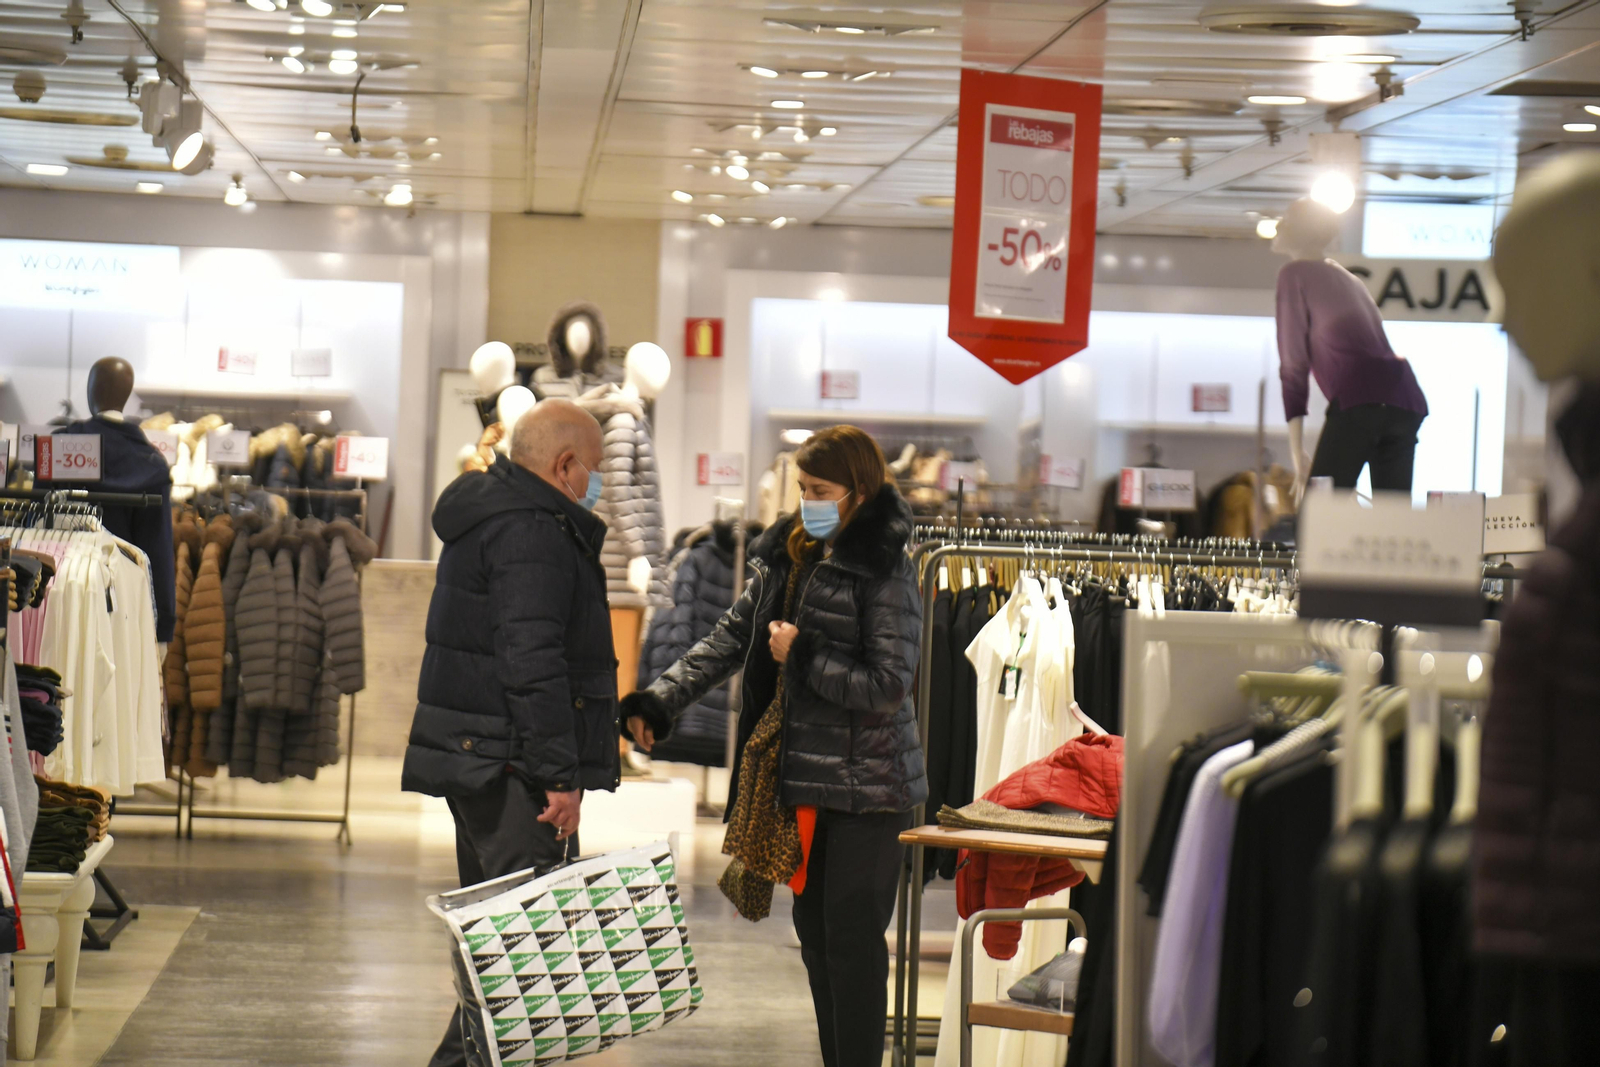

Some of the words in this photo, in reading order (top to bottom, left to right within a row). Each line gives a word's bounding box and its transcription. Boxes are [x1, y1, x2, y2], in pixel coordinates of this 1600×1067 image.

[1008, 123, 1054, 145] rebajas
[998, 169, 1067, 205] TODO
[988, 227, 1062, 272] -50%
[61, 441, 93, 452] TODO
[55, 453, 98, 468] -30%
